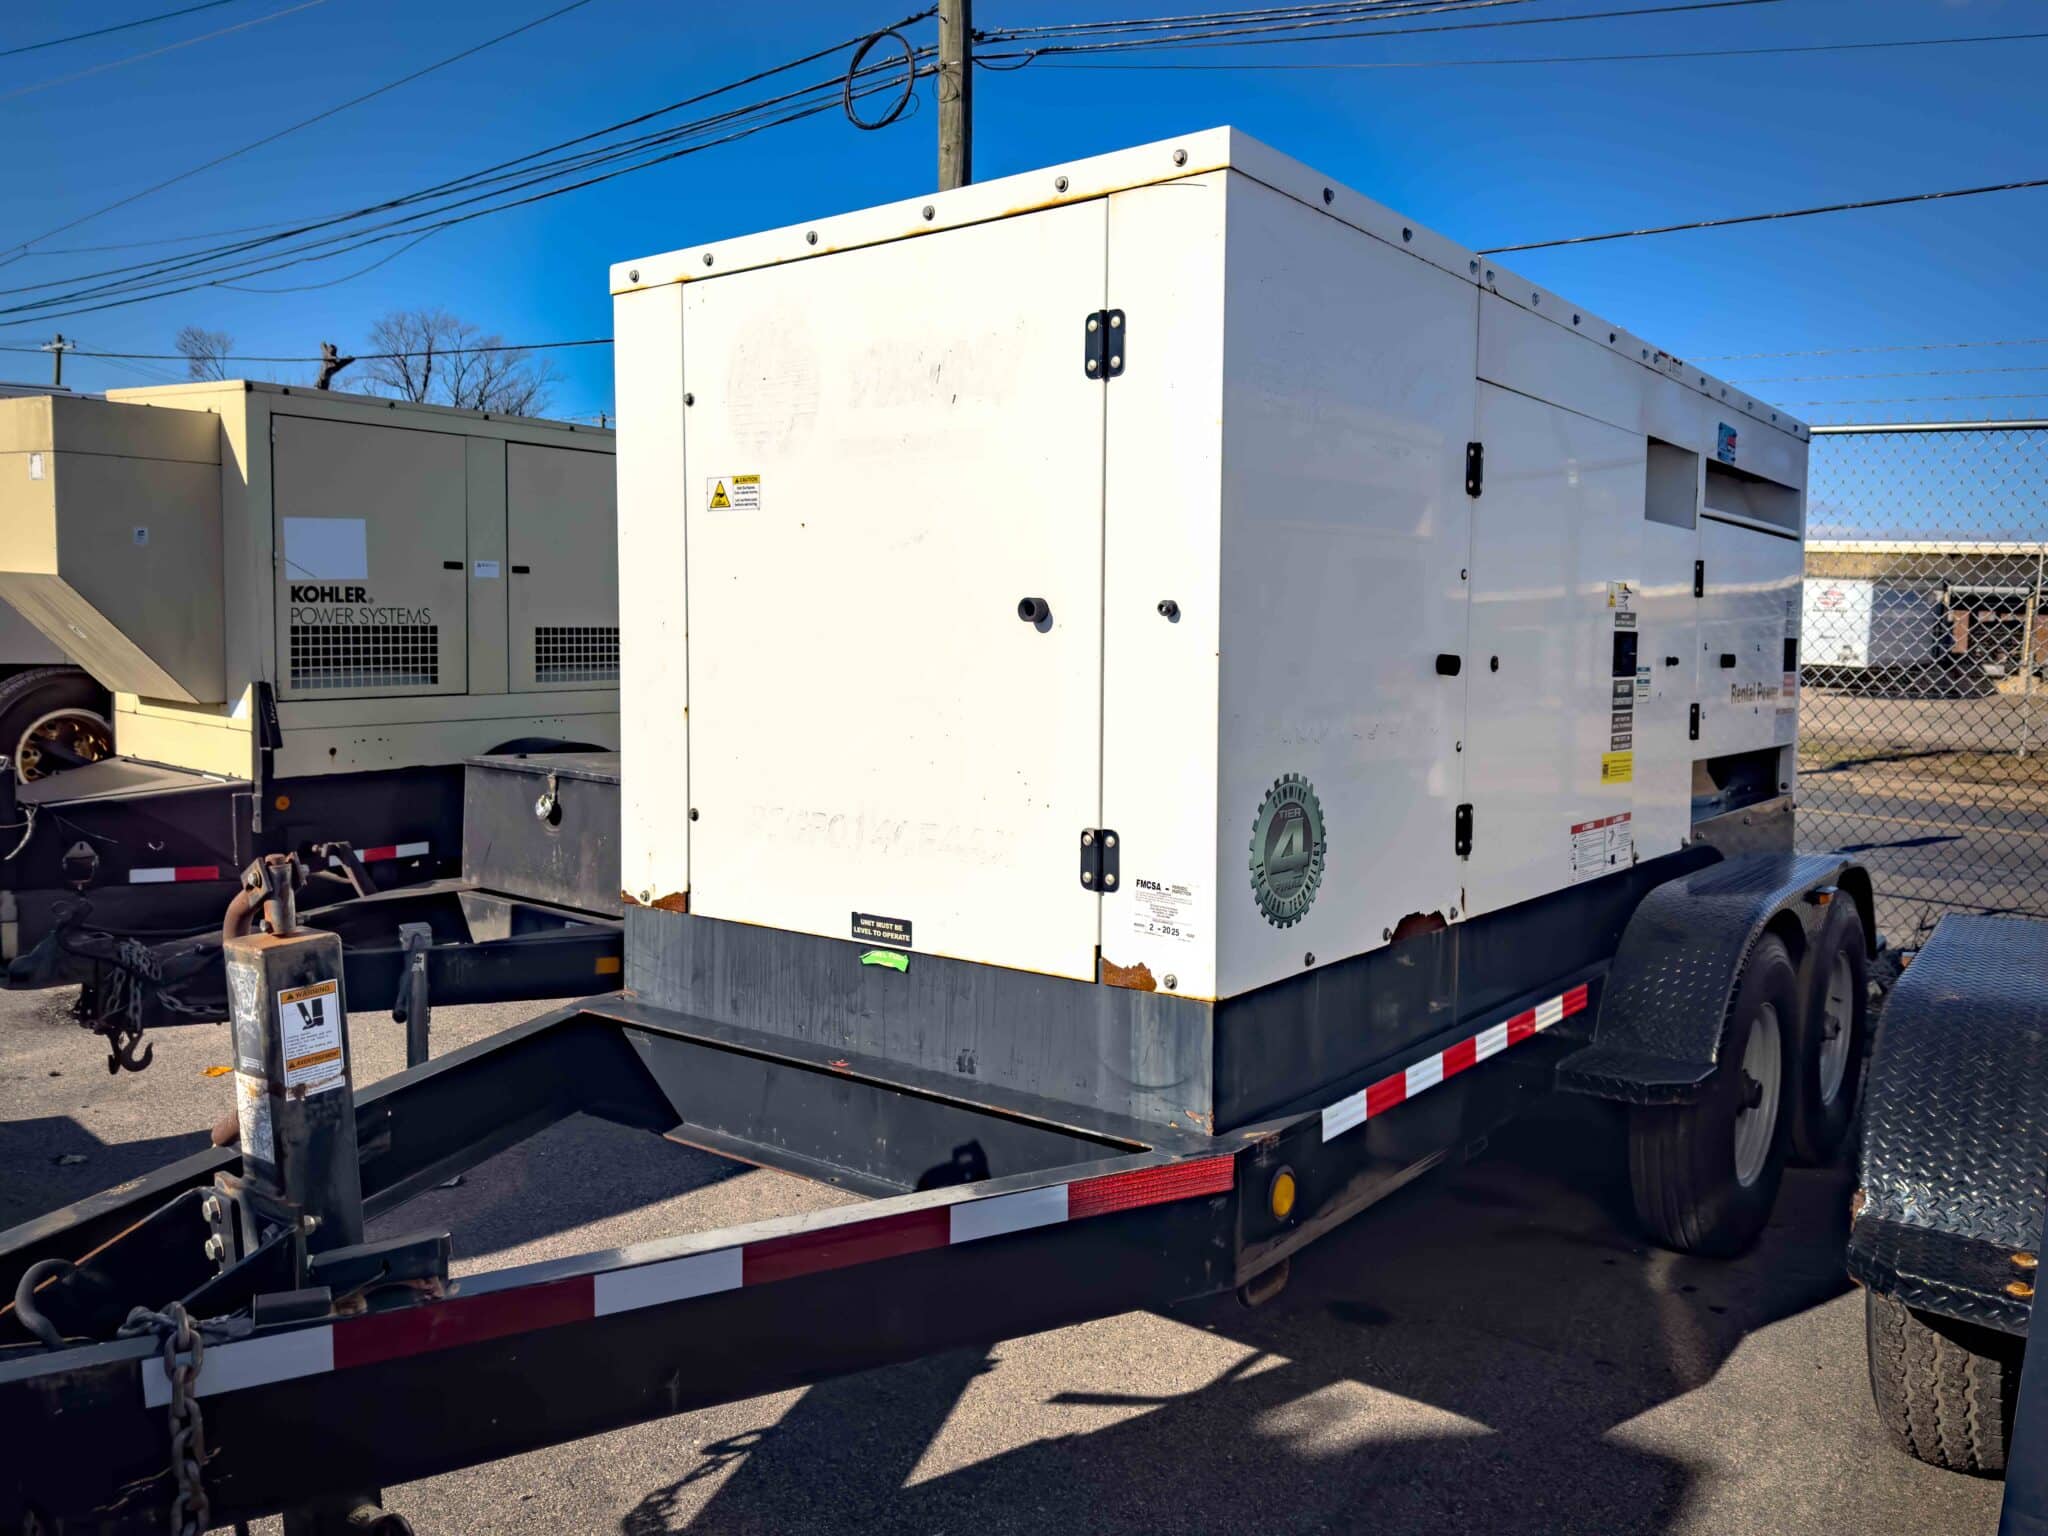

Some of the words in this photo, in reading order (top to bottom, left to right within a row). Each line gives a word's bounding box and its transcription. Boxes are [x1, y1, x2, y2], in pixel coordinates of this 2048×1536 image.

[291, 586, 368, 603] KOHLER
[291, 607, 354, 625] POWER
[360, 607, 432, 625] SYSTEMS
[1731, 683, 1757, 703] Rental
[1279, 808, 1301, 819] TIER
[1270, 818, 1309, 875] 4
[1256, 863, 1267, 888] THE
[1136, 879, 1161, 891] FMCSA
[853, 926, 872, 935] LEVEL
[873, 929, 882, 937] TO
[882, 931, 911, 942] OPERATE
[876, 922, 893, 930] MUST
[1149, 923, 1154, 931] 2
[295, 984, 330, 997] WARNING
